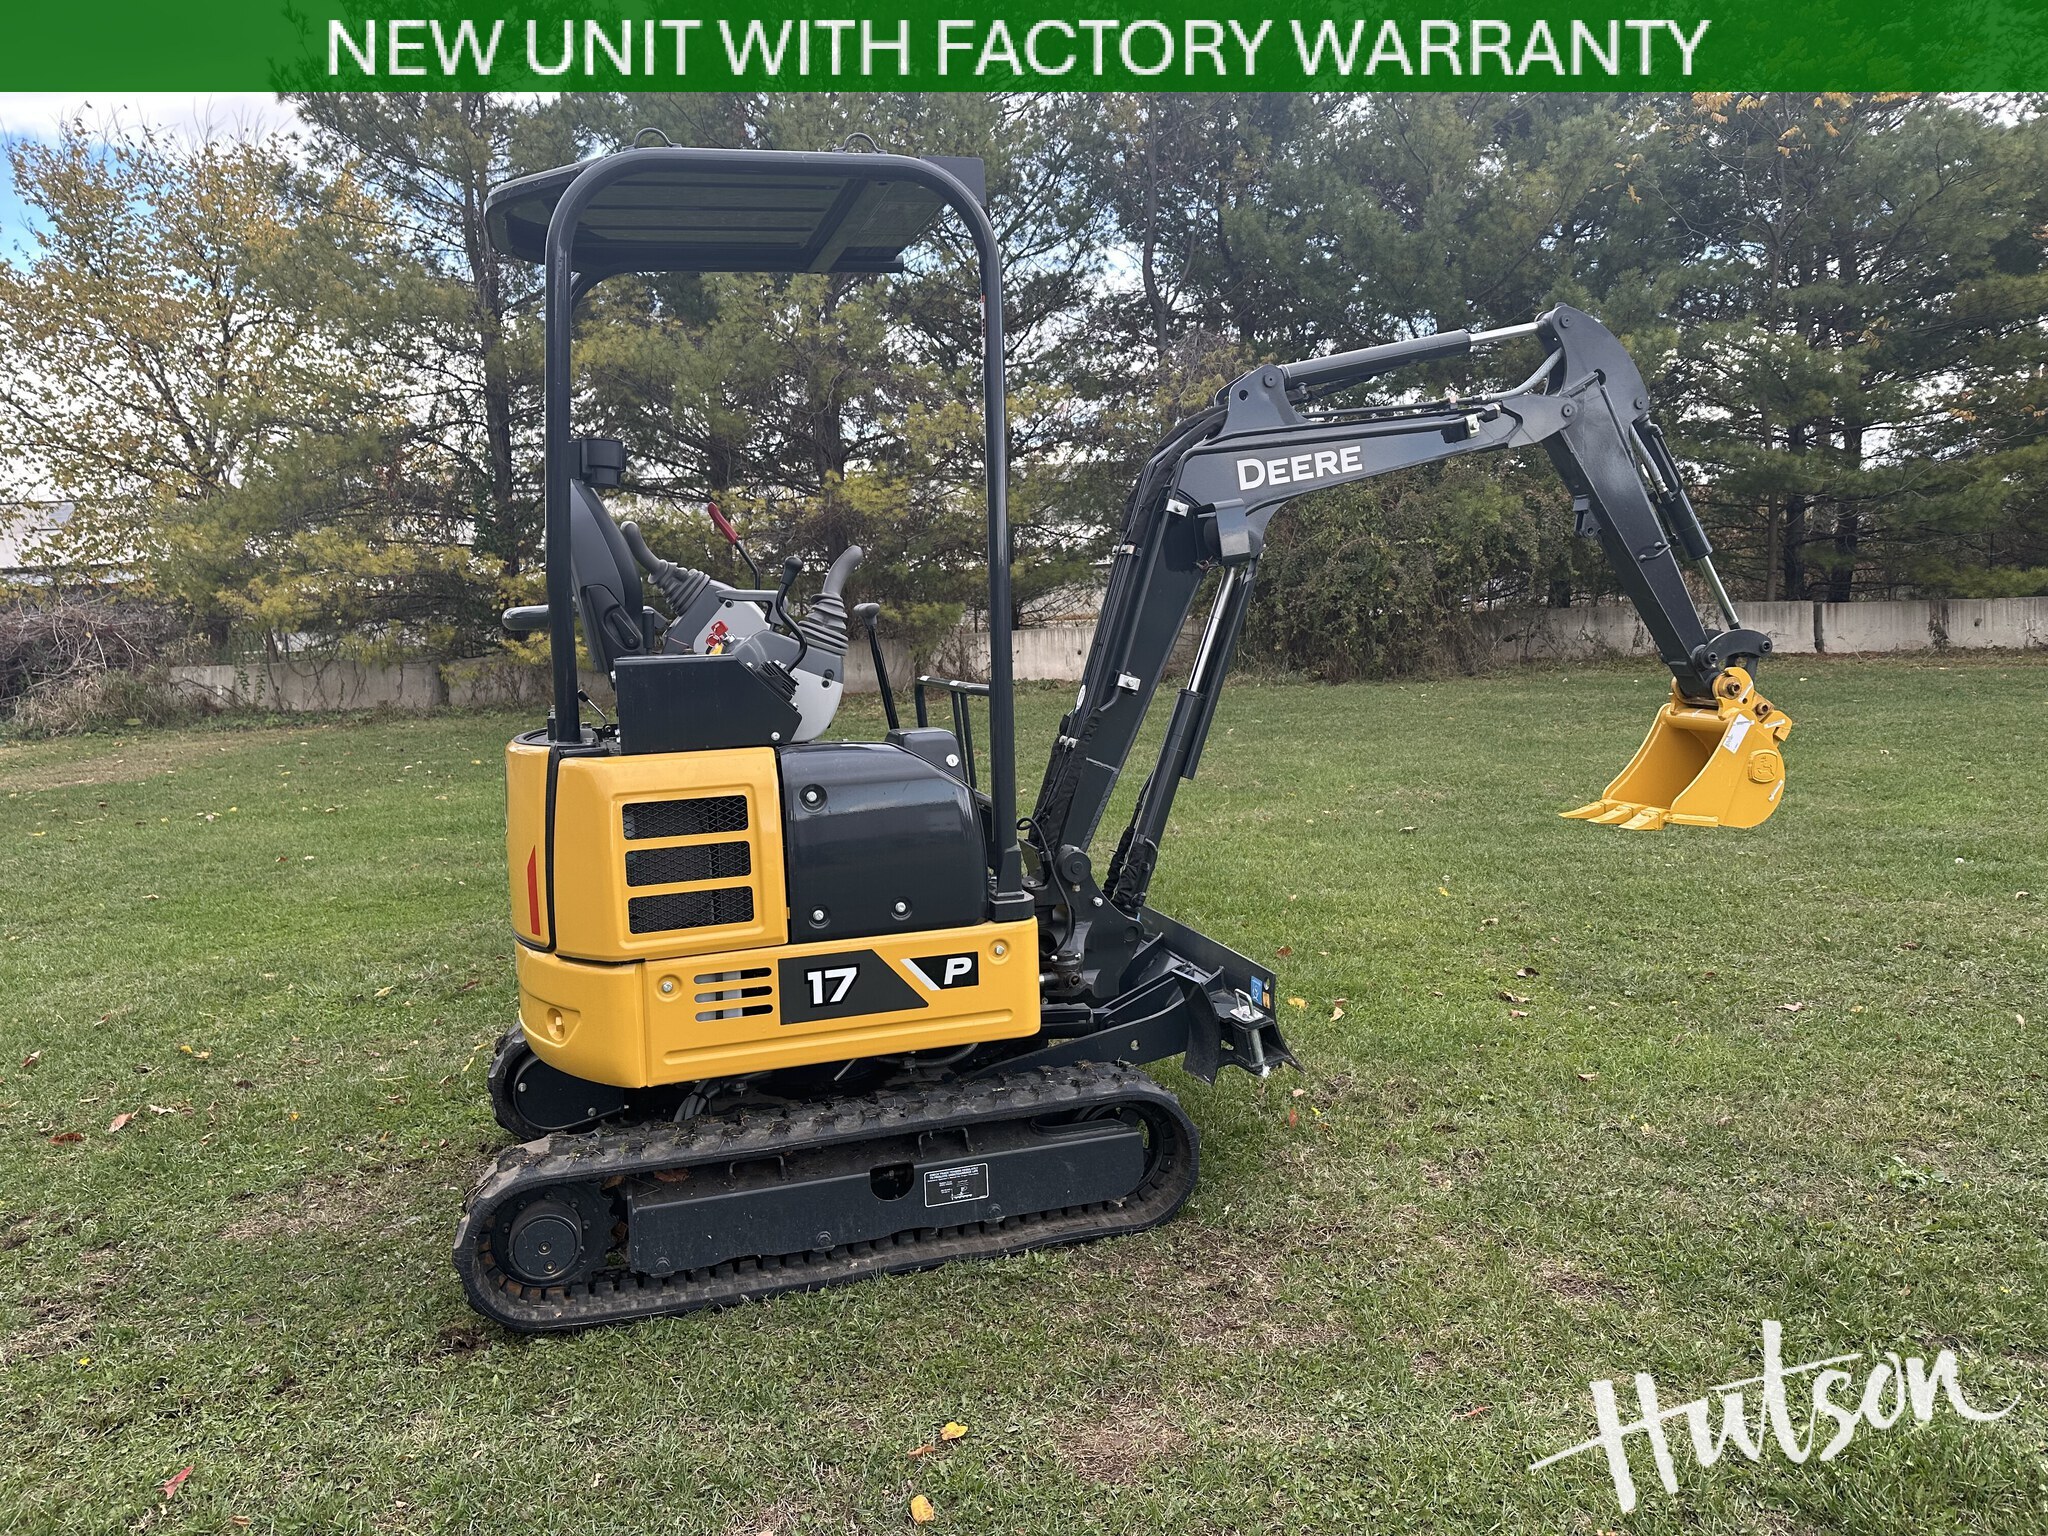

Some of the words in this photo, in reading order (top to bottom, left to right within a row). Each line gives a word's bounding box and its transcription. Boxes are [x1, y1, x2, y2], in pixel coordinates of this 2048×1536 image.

[1236, 445, 1363, 491] DEERE
[807, 966, 857, 1005] 17
[943, 957, 973, 985] P
